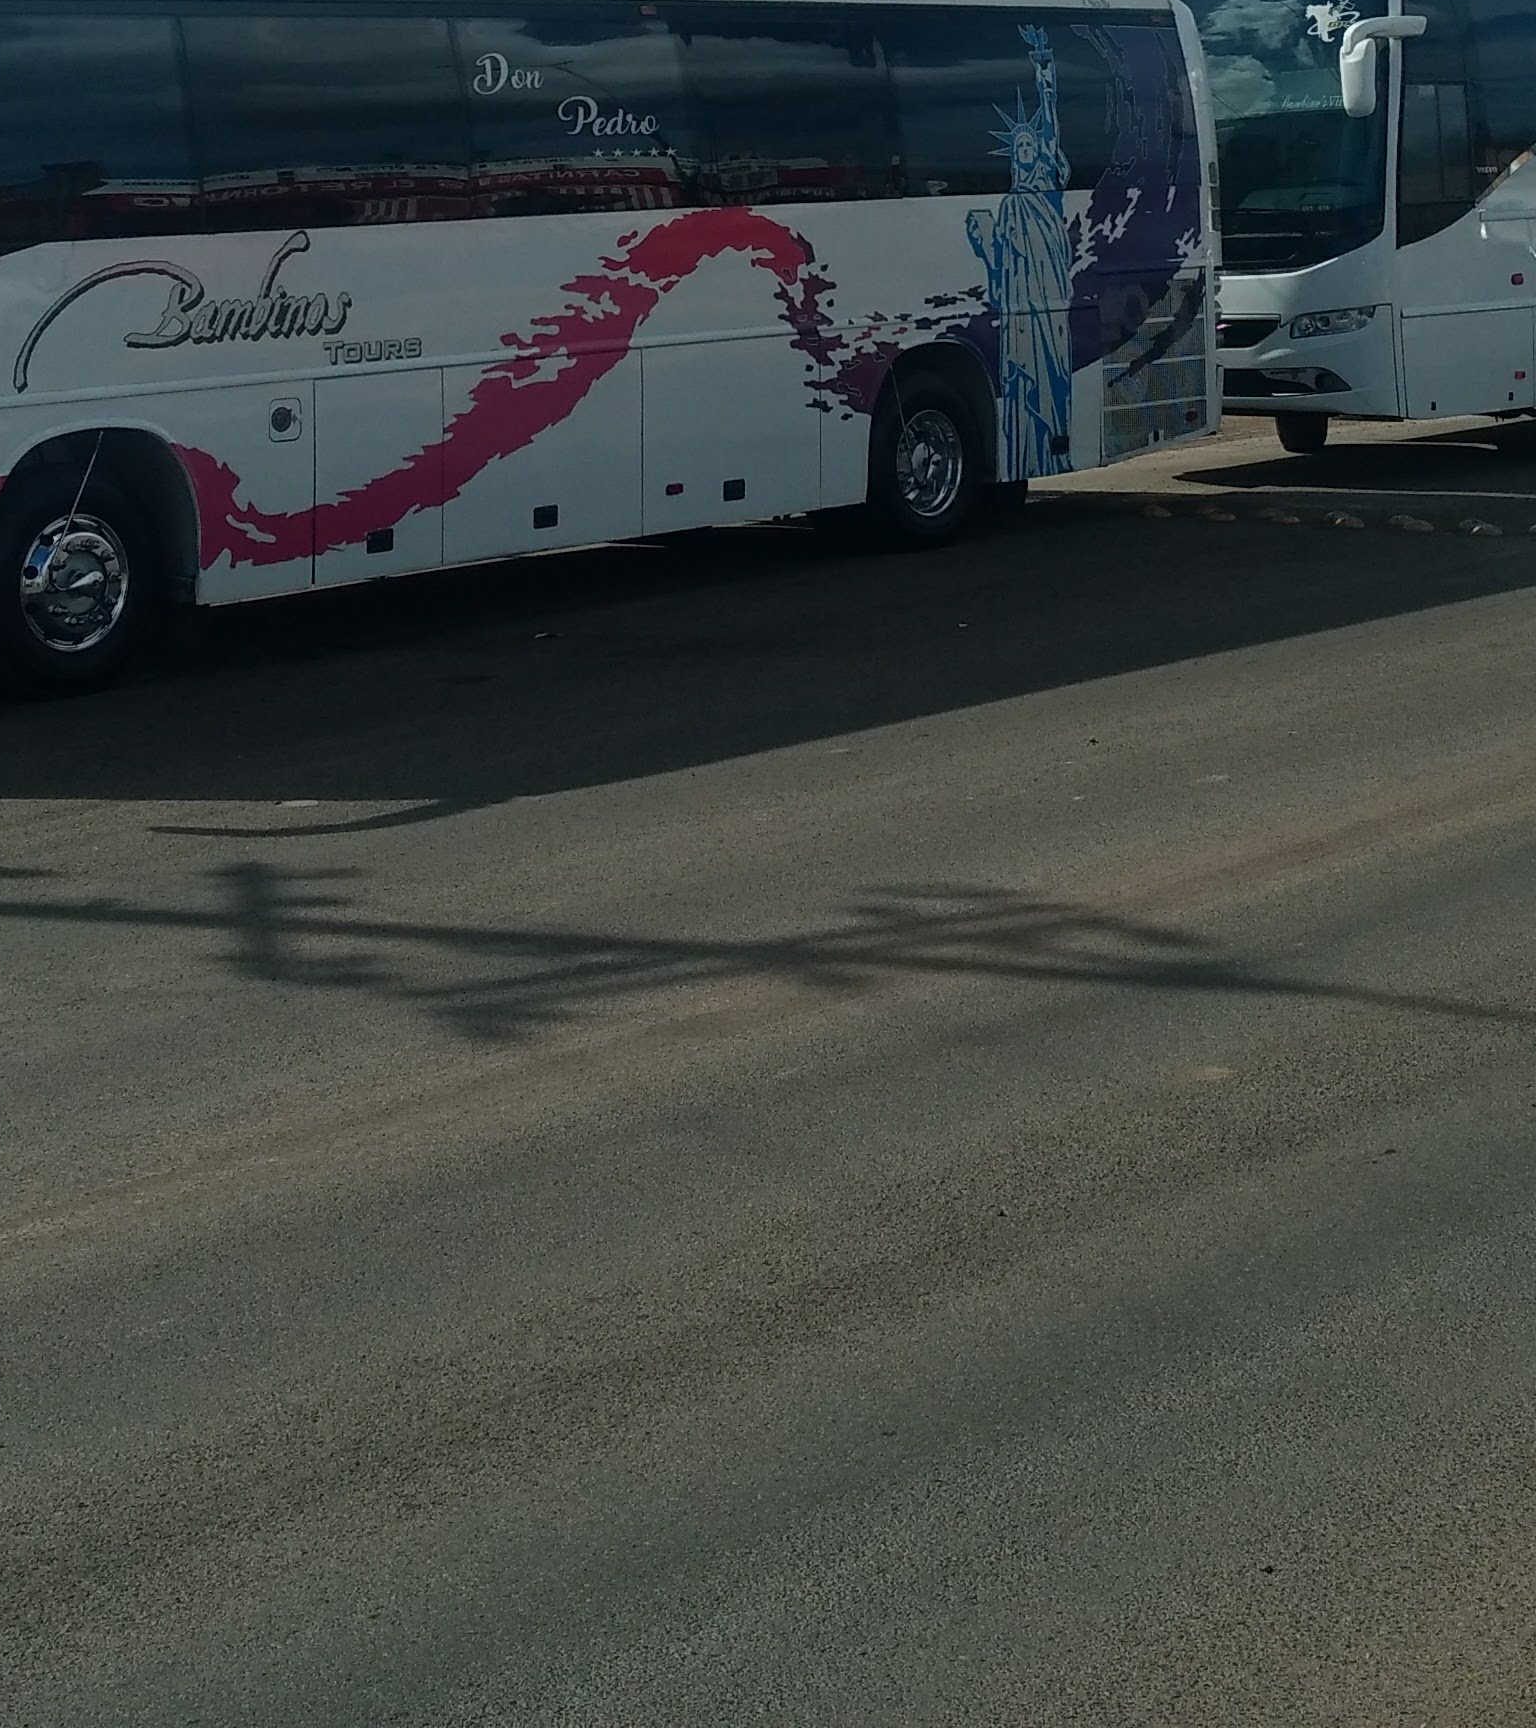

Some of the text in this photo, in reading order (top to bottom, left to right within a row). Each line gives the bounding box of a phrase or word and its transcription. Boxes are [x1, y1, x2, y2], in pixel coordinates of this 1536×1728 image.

[472, 52, 544, 95] Don
[557, 95, 660, 136] Pedro
[322, 337, 423, 366] TOURS
